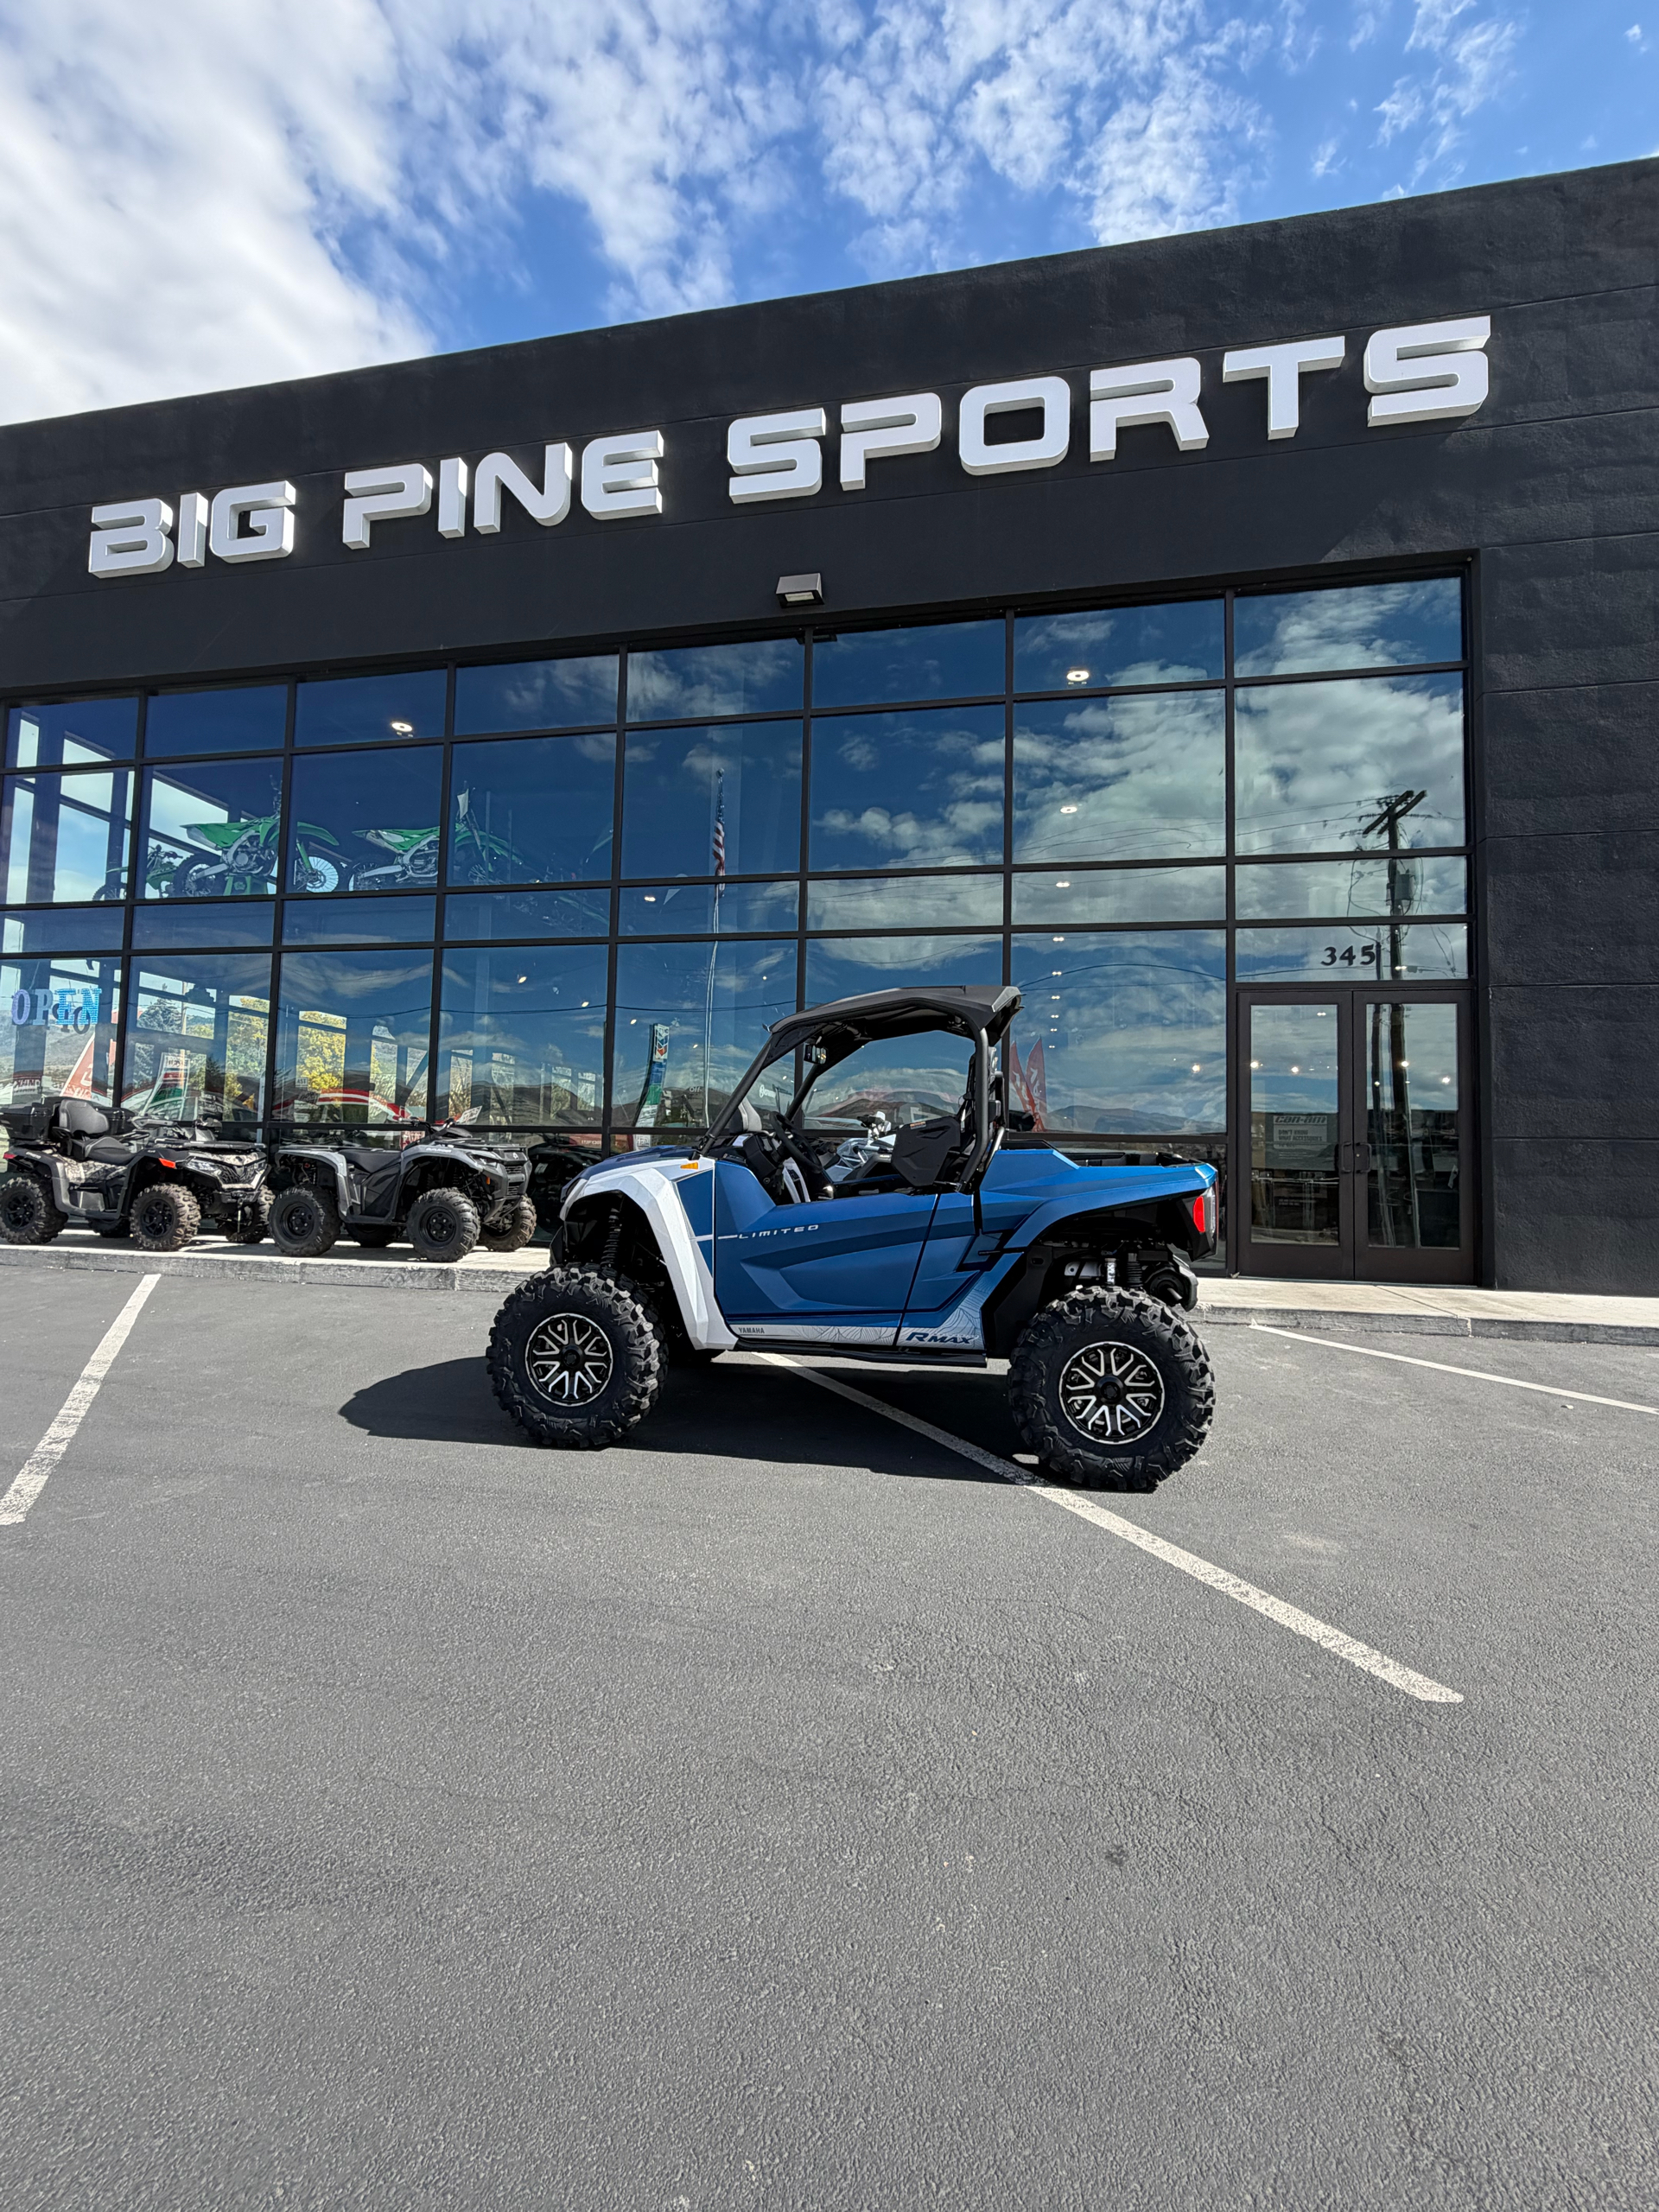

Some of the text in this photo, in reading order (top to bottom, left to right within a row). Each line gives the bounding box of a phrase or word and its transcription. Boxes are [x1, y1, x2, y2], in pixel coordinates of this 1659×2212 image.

[88, 315, 1491, 579] BIG PINE SPORTS
[1320, 944, 1376, 966] 345
[11, 988, 102, 1026] OPEN
[738, 1224, 819, 1239] LIMITED
[906, 1332, 974, 1344] RMAX
